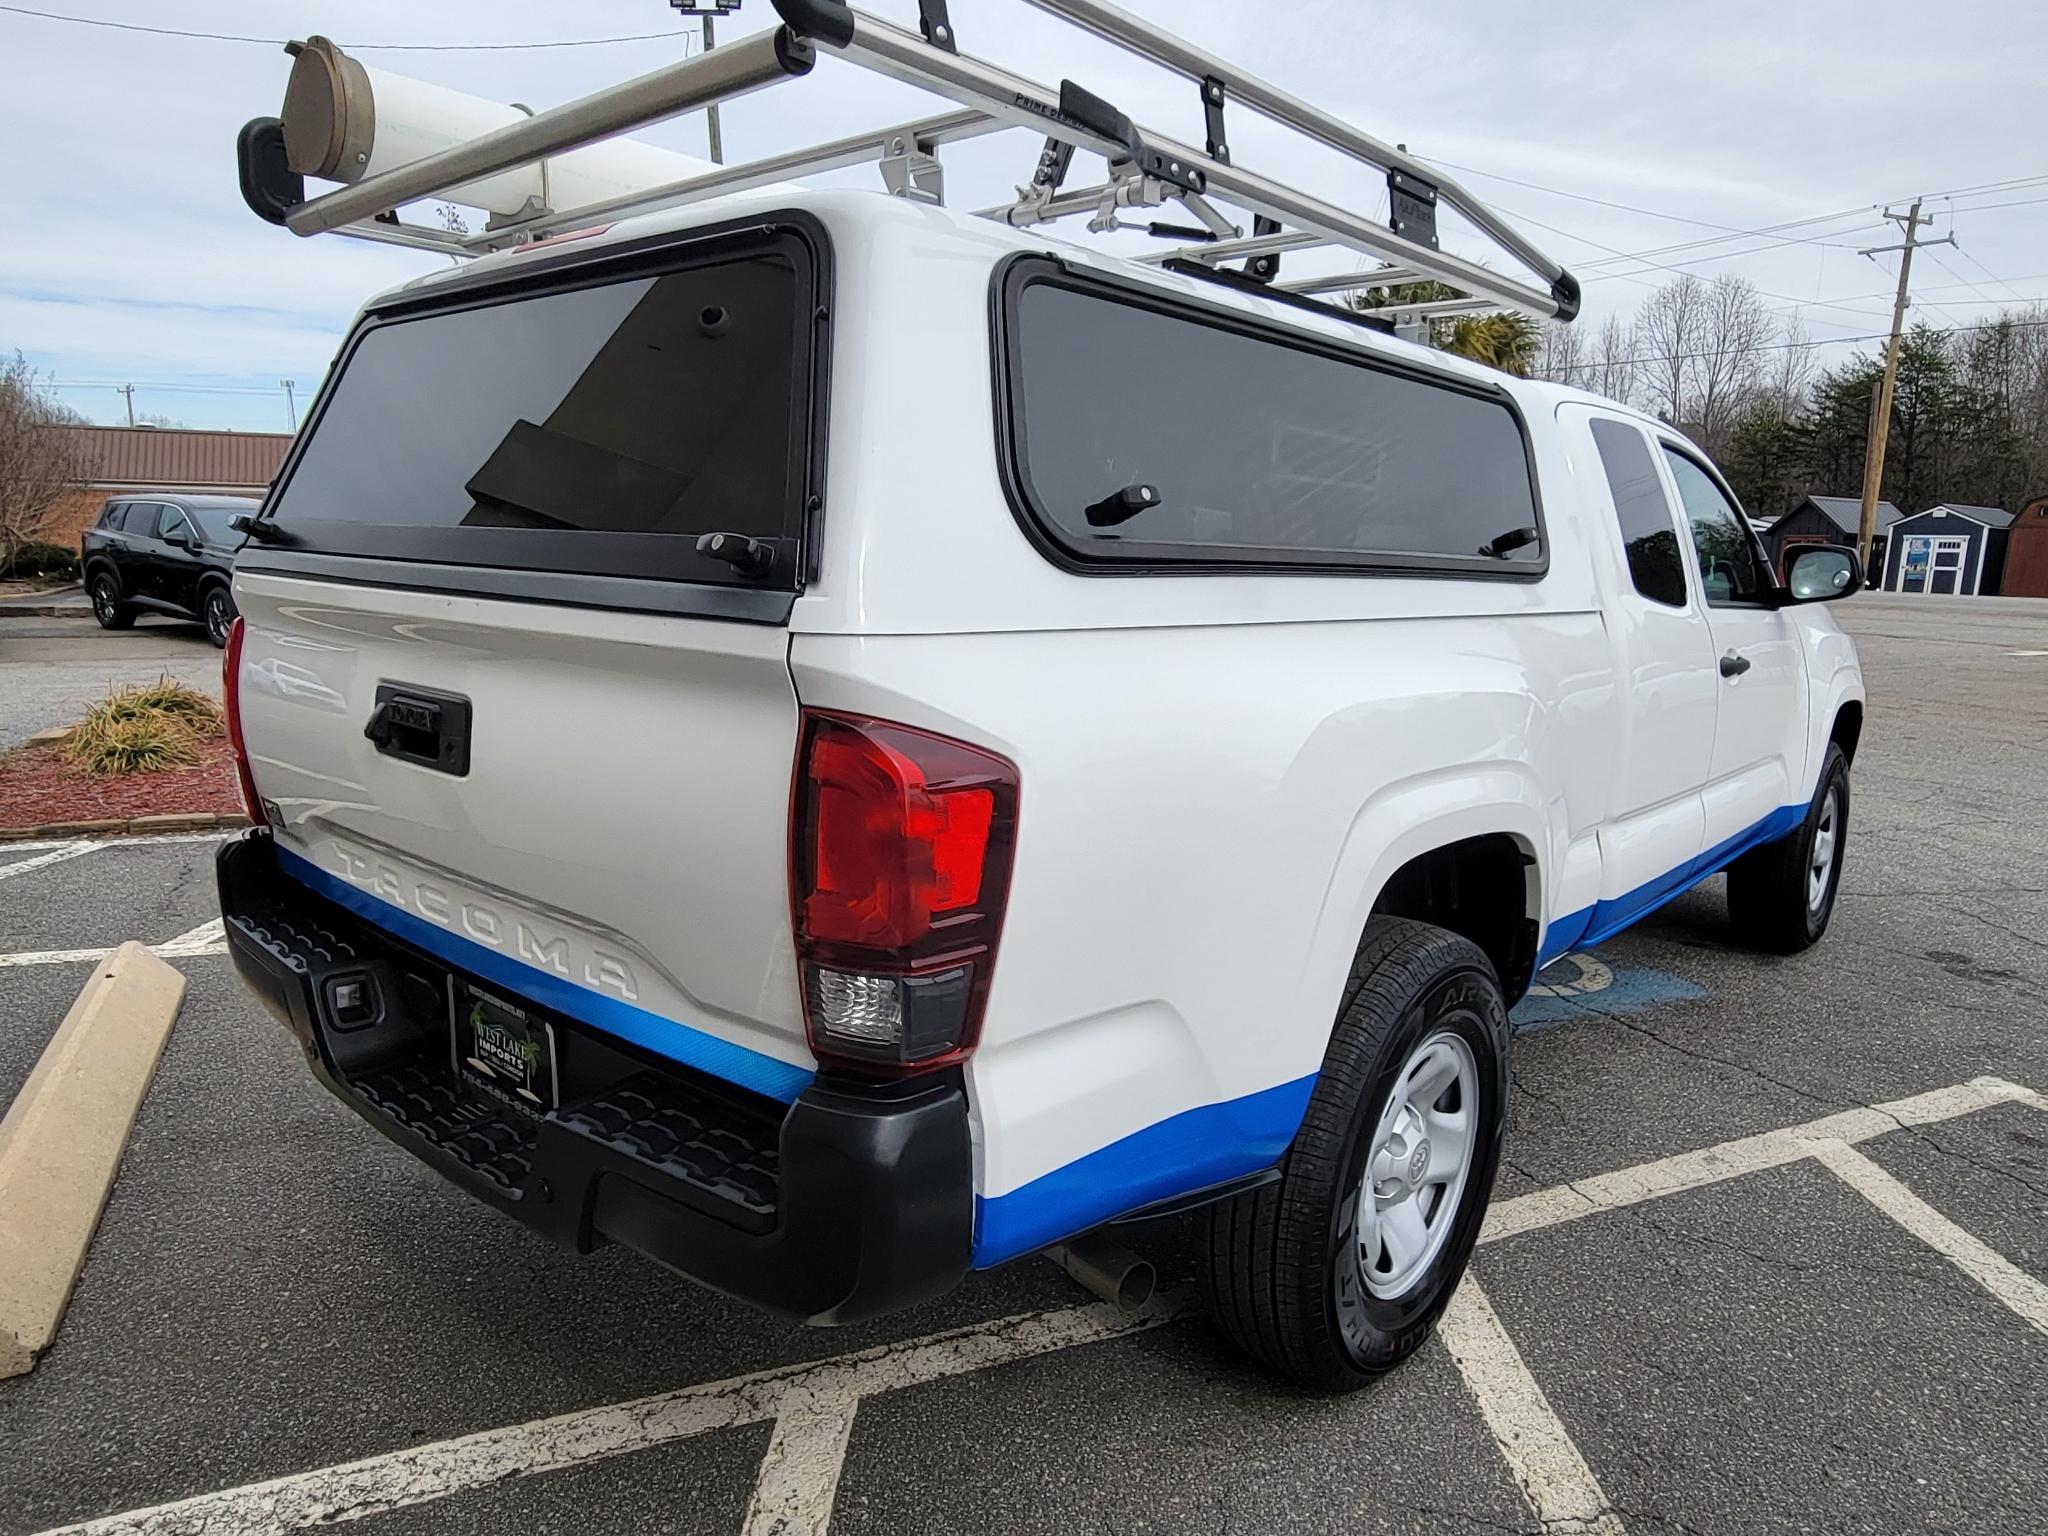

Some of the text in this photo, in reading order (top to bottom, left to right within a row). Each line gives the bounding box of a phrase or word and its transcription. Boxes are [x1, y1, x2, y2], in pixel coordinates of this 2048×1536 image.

[1015, 92, 1048, 113] PRIME
[332, 842, 639, 1001] TACOMA
[476, 1021, 528, 1061] WEST LAKE
[479, 1038, 524, 1070] IMPORTS
